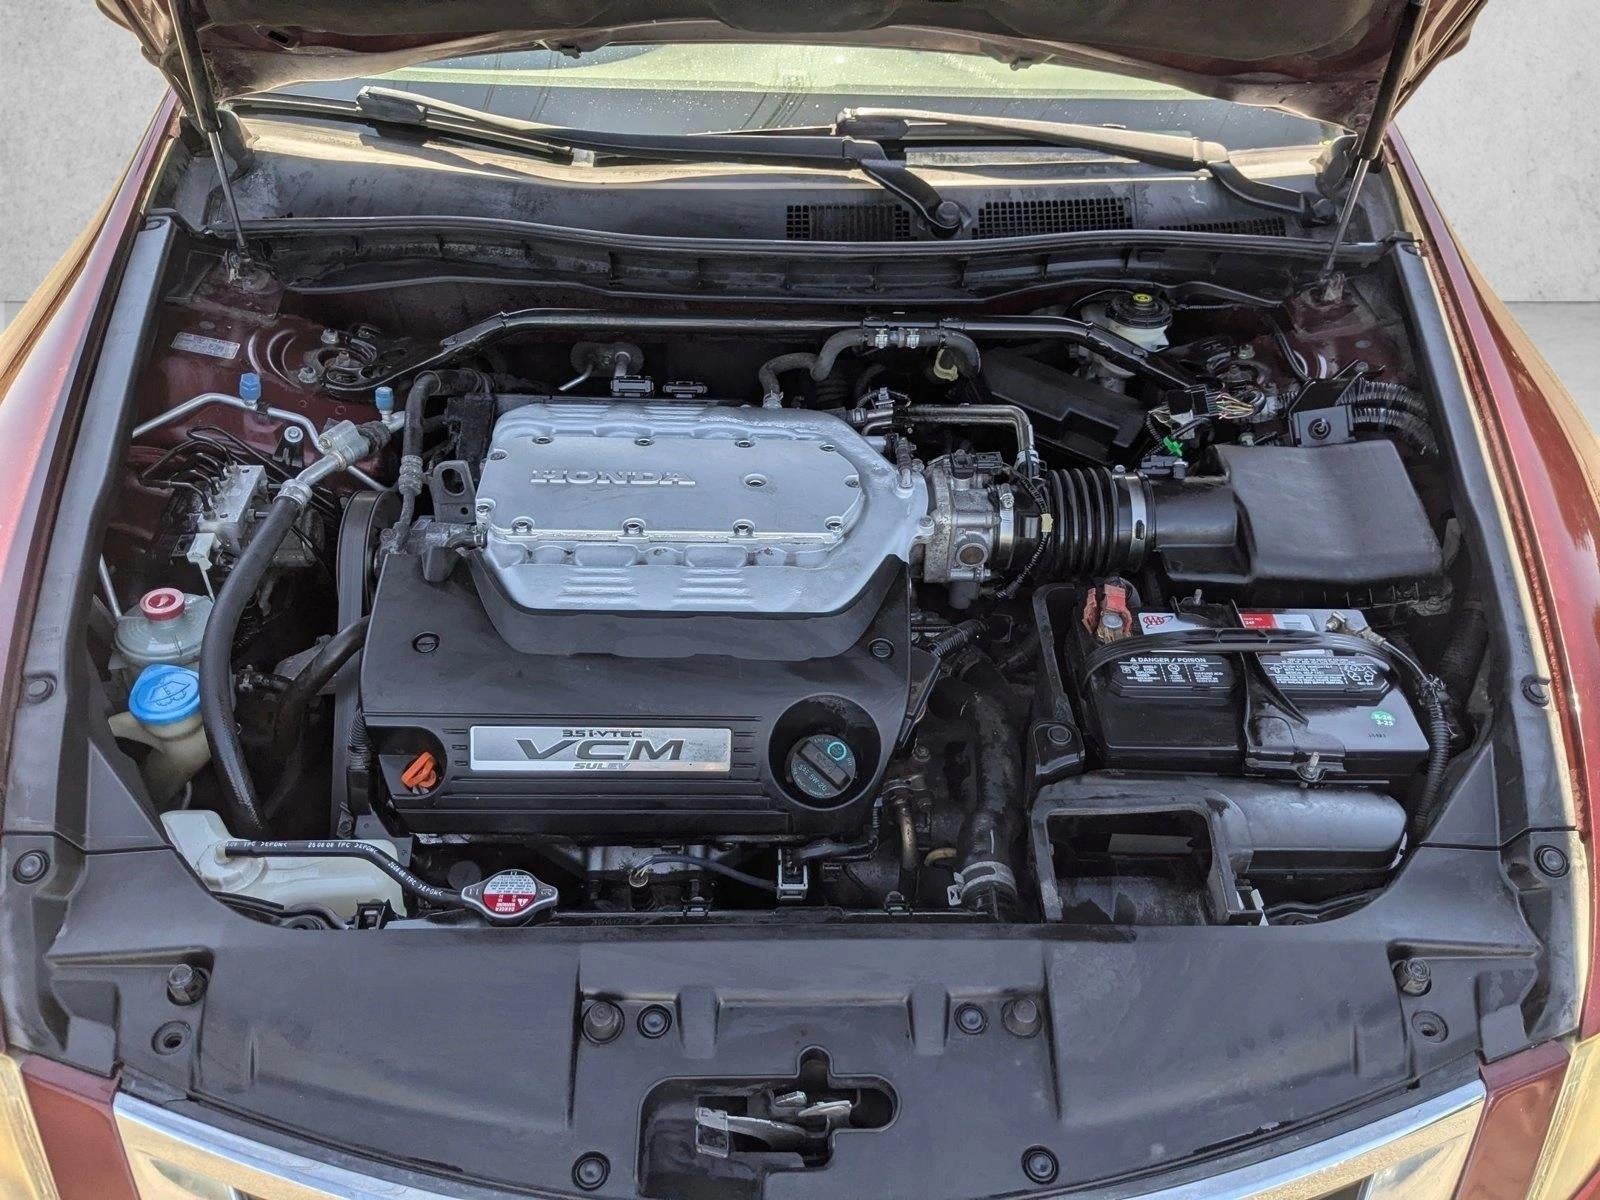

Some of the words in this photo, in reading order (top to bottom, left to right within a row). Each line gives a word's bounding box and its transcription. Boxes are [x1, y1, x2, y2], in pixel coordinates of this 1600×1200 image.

[530, 469, 696, 485] HONDA
[1142, 615, 1165, 626] AAA
[562, 729, 586, 738] 3.5
[588, 729, 642, 738] i-VTEC
[515, 738, 685, 761] VCM
[572, 762, 632, 771] SULEV
